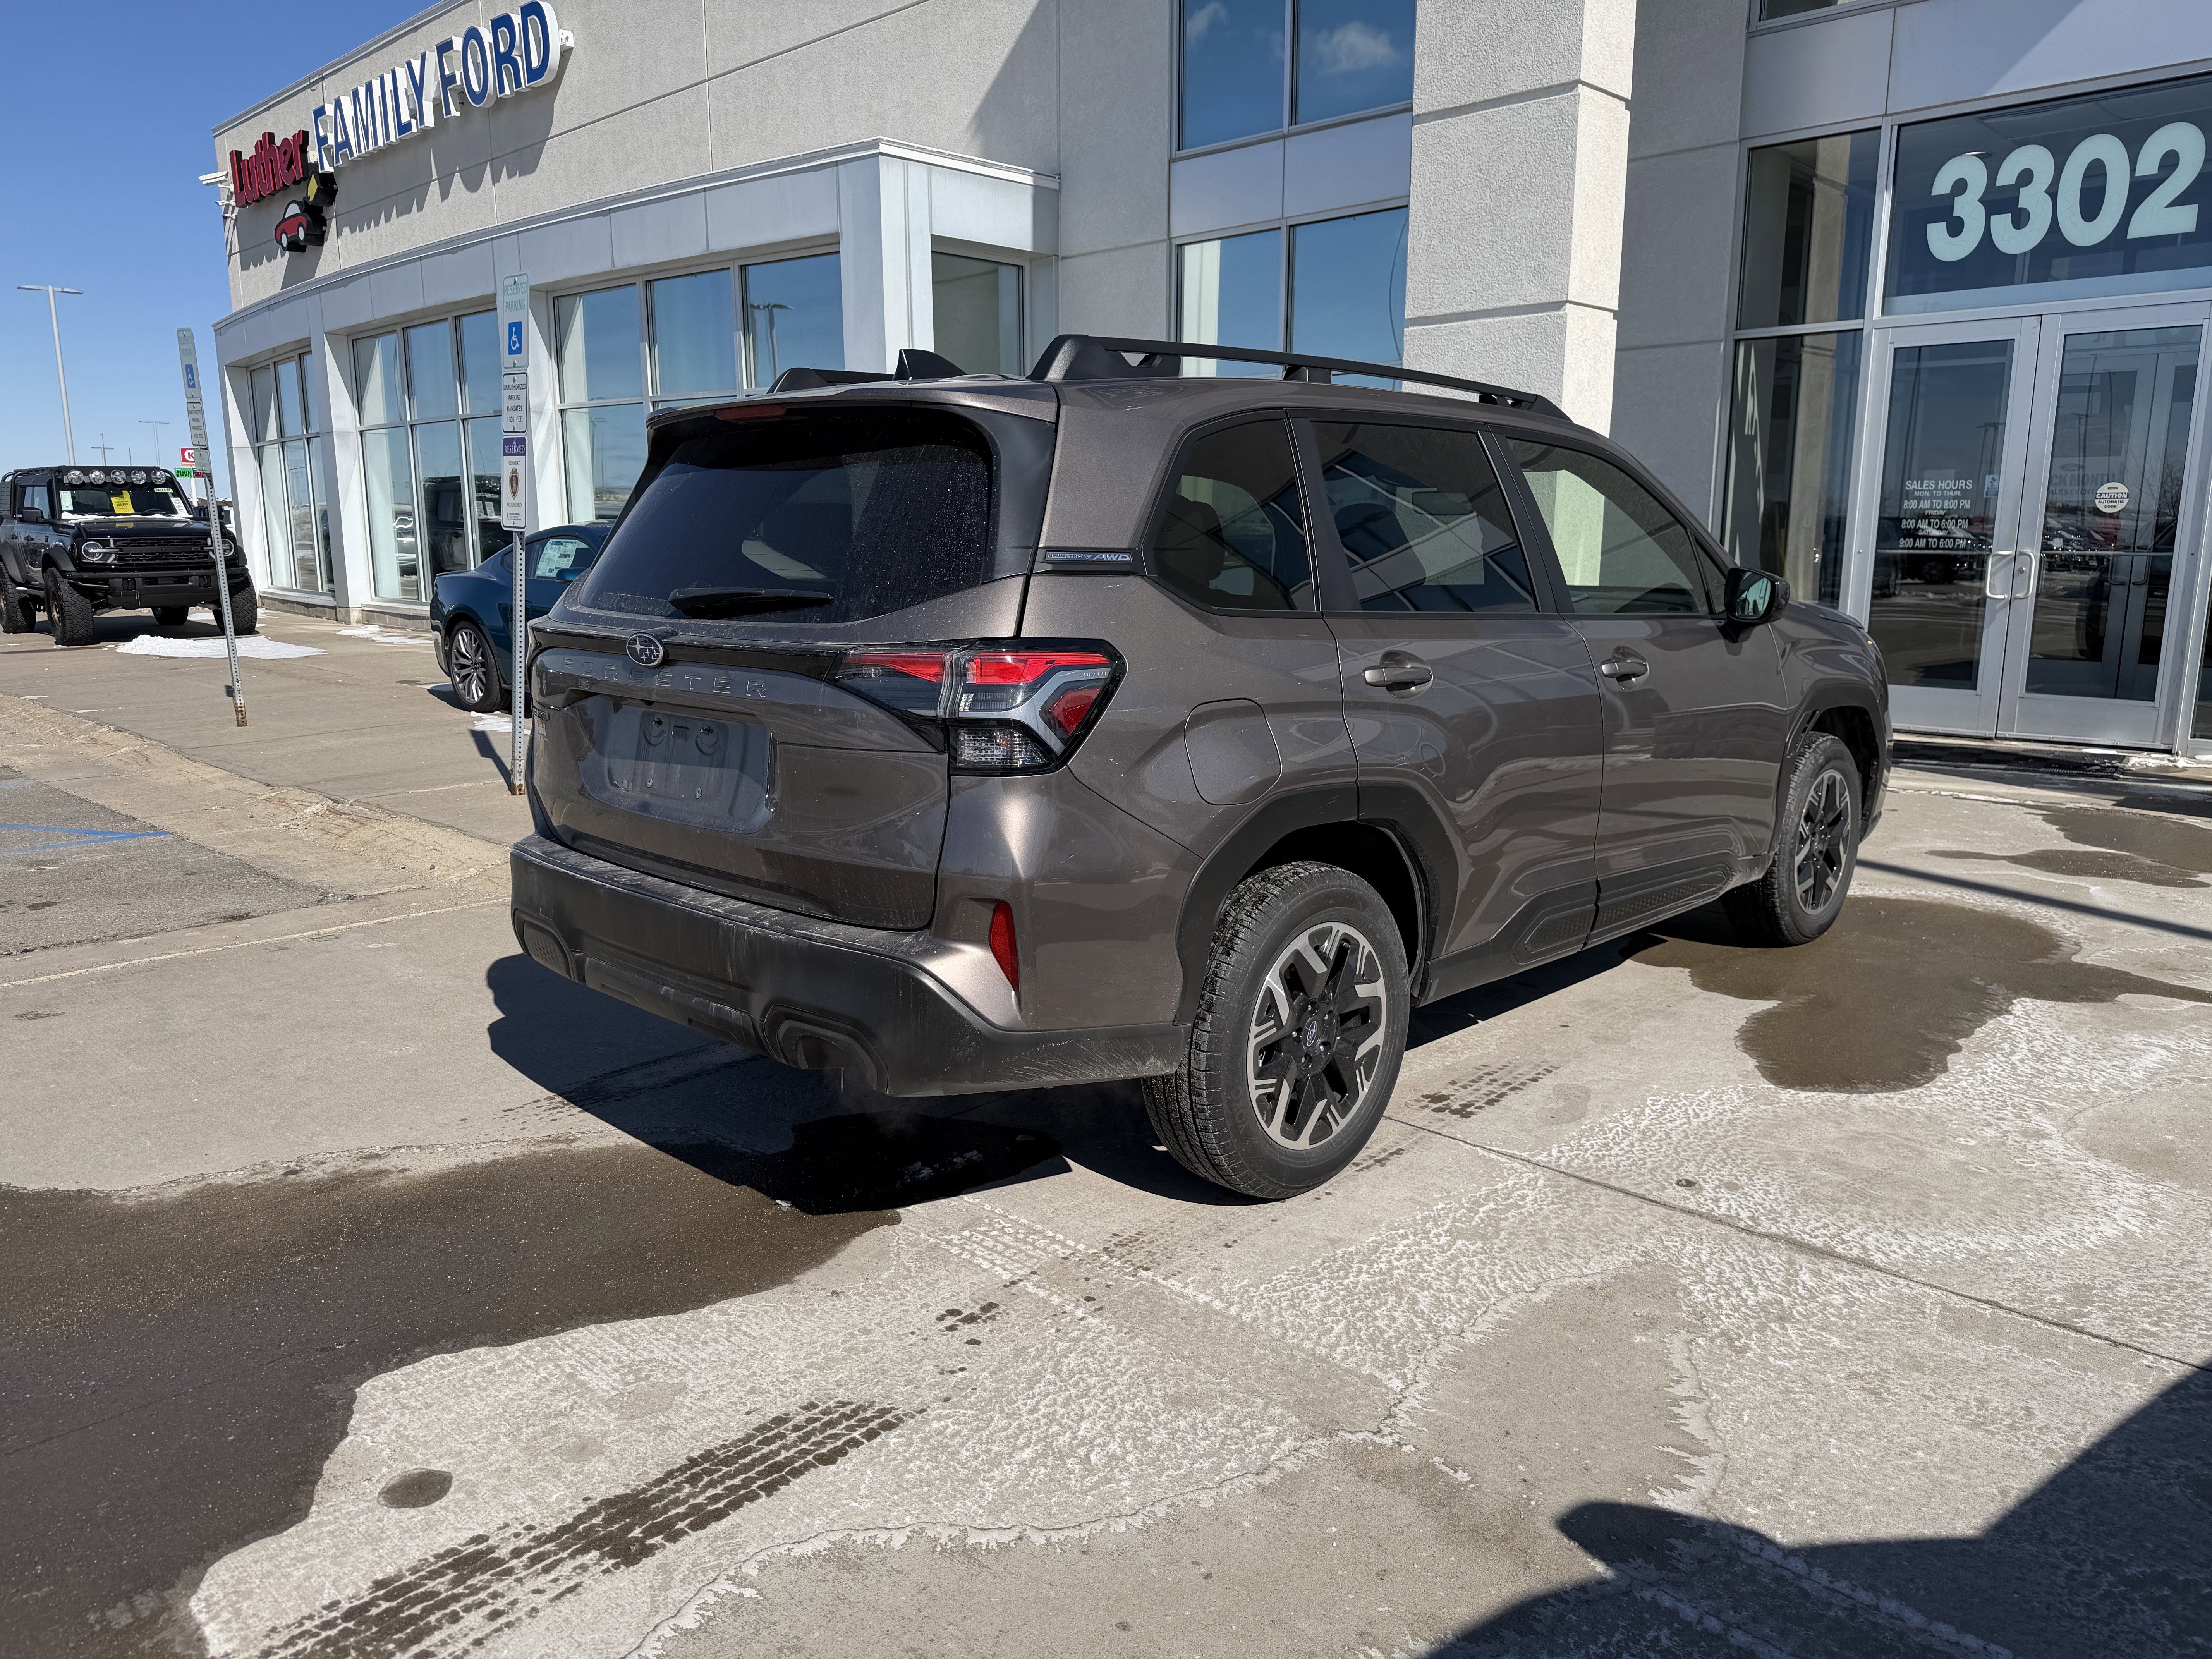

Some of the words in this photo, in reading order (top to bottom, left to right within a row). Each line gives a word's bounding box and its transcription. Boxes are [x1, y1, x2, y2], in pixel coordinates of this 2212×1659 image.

[313, 51, 431, 173] FAMILY
[434, 0, 554, 118] FORD
[229, 129, 304, 208] Luther
[1927, 122, 2206, 261] 3302
[504, 282, 527, 297] RESERVED
[505, 299, 525, 313] PARKING
[504, 445, 525, 453] RESERVED
[1906, 480, 1935, 489] SALES
[1938, 480, 1973, 489] HOURS
[1903, 500, 1917, 509] 8:00
[1918, 500, 1930, 509] AM
[1932, 500, 1942, 509] TO
[1944, 499, 1958, 509] 8:00
[1959, 499, 1971, 509] PM
[1901, 519, 1915, 529] 8:00
[1917, 519, 1929, 529] AM
[1930, 519, 1940, 529] TO
[1941, 519, 1956, 529] 6:00
[1957, 519, 1968, 529] PM
[1899, 538, 1913, 548] 9:00
[1914, 538, 1926, 548] AM
[1928, 538, 1938, 548] TO
[1939, 538, 1954, 548] 6:00
[1955, 538, 1966, 548] PM
[562, 658, 766, 697] FORESTER
